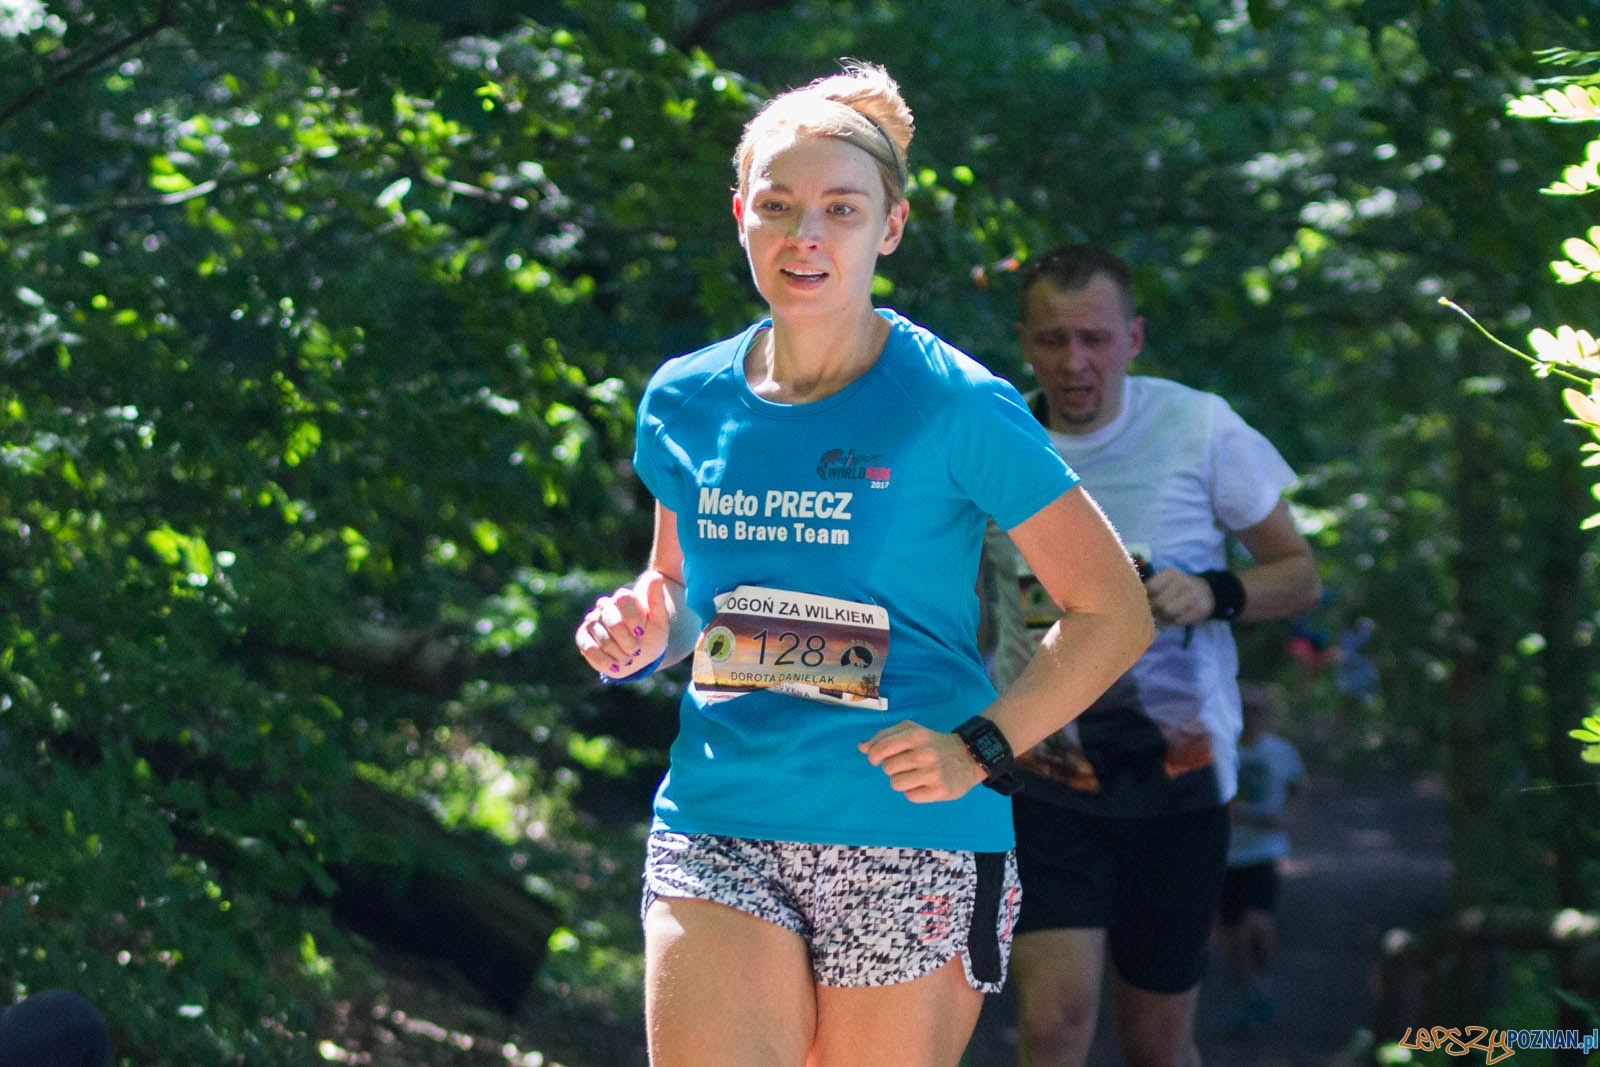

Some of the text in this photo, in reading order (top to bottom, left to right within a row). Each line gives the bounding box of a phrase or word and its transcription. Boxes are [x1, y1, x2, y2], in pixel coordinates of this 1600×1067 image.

[870, 481, 890, 489] 2017
[698, 487, 853, 519] Meto PRECZ
[697, 519, 849, 545] The Brave Team
[727, 596, 874, 625] OGOŃ ZA WILKIEM
[753, 628, 826, 667] 128
[731, 671, 835, 684] DOROTA DANIELAK
